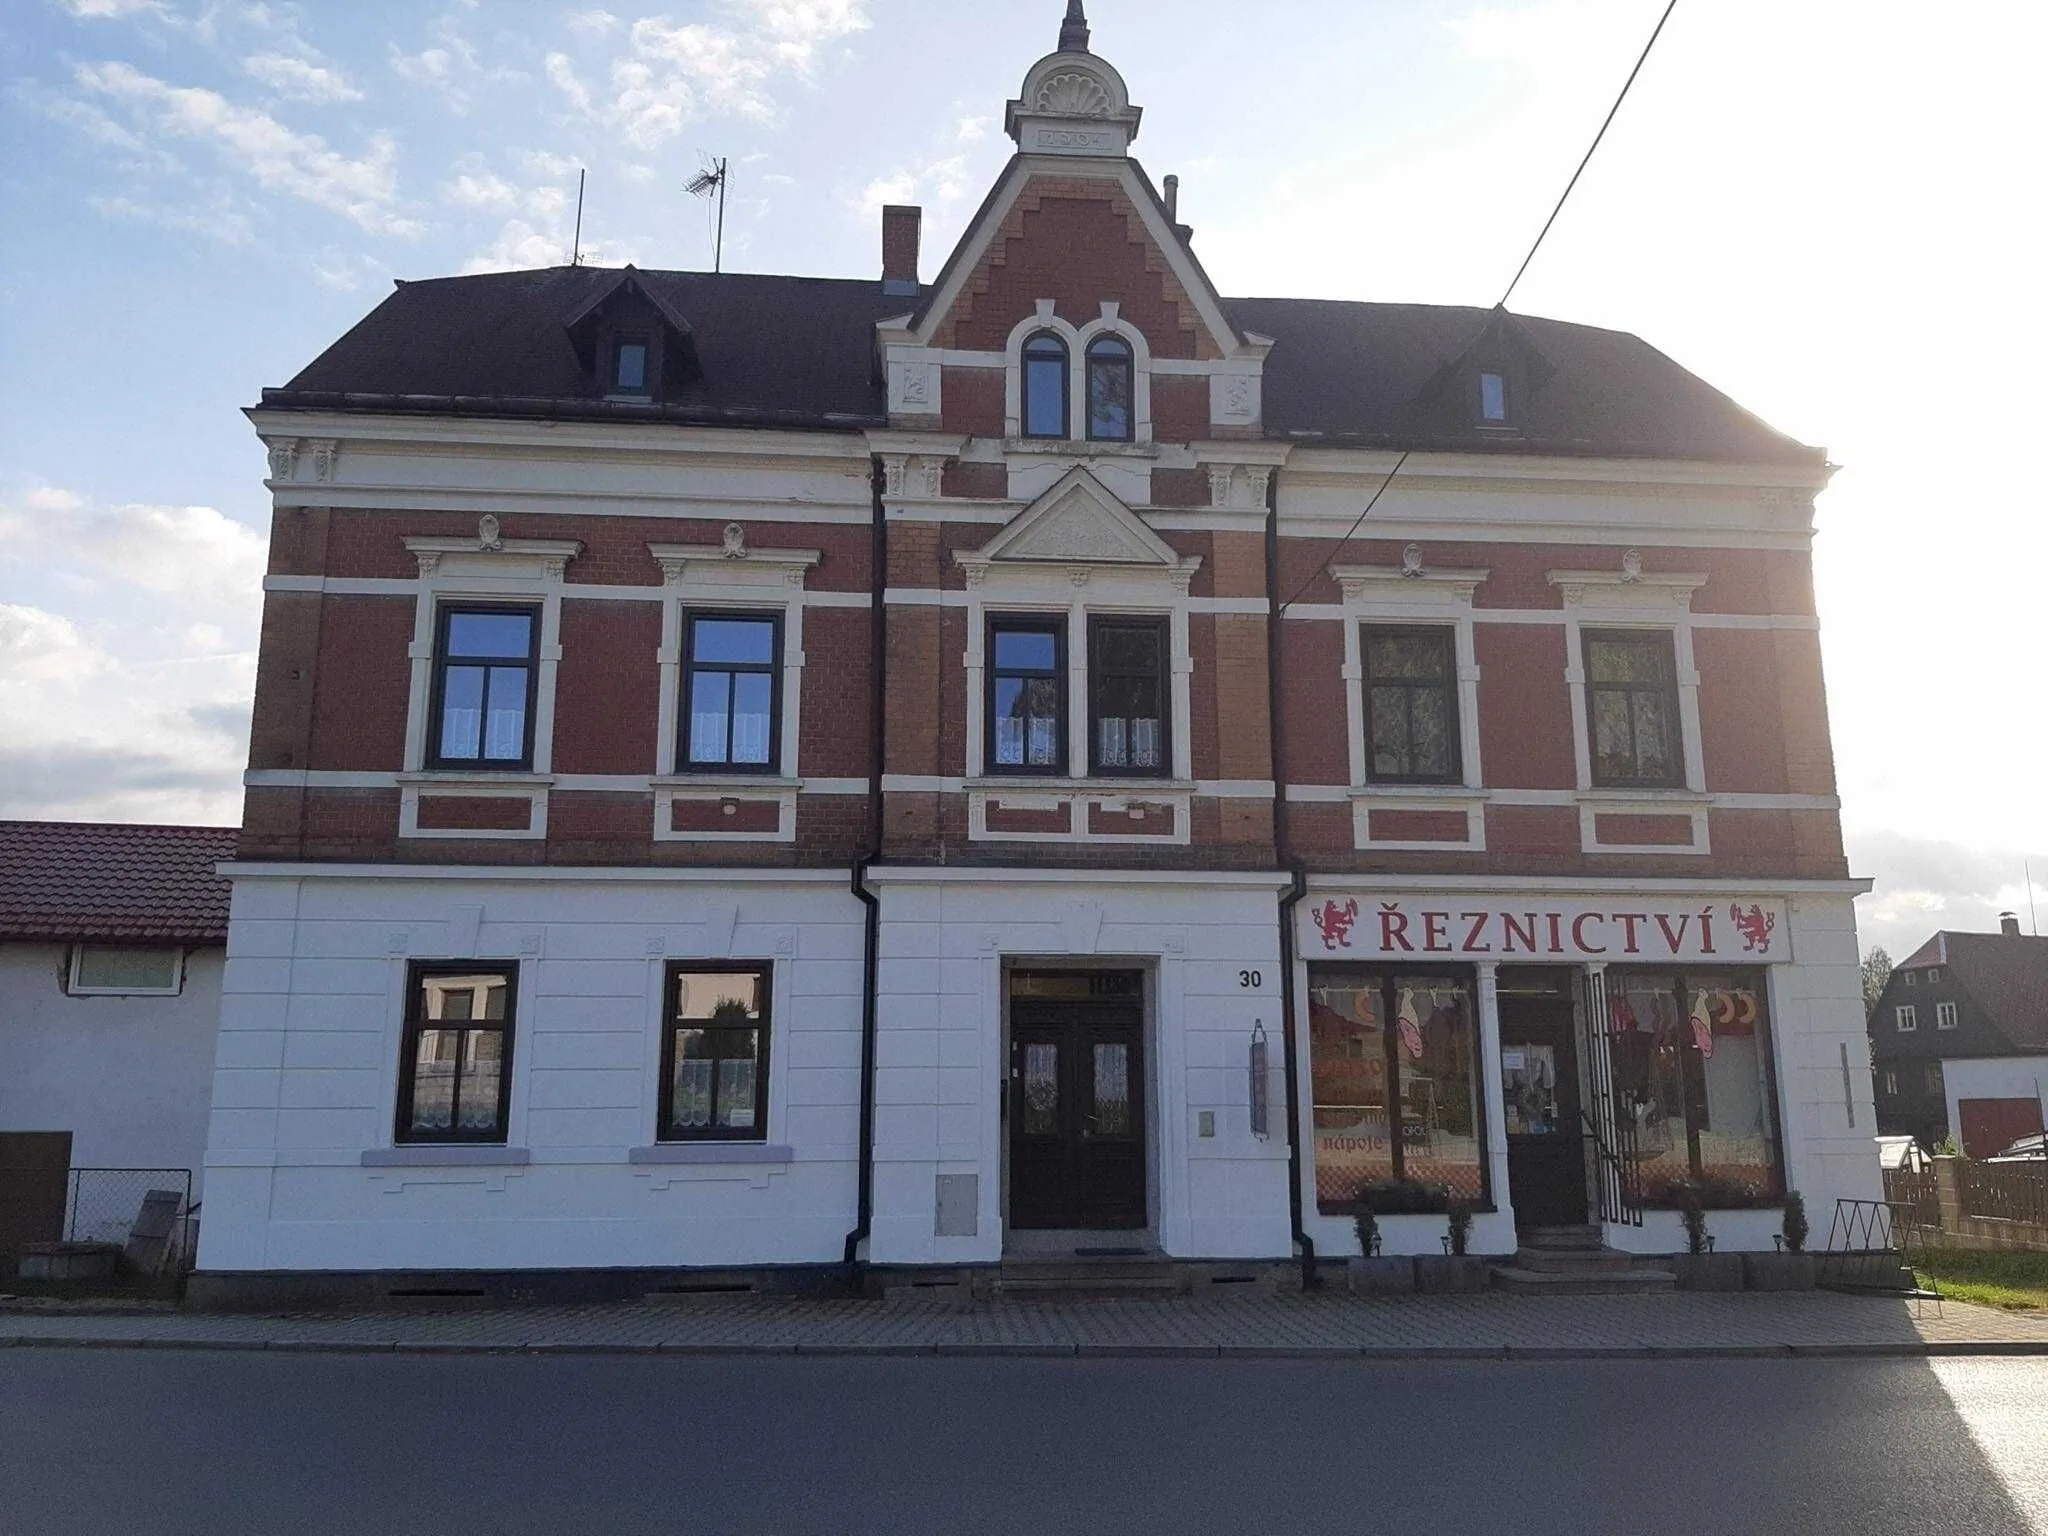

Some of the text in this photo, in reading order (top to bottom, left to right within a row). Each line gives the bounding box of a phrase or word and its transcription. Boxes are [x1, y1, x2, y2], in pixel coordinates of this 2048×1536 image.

[1378, 902, 1717, 954] ŘEZNICTVÍ
[1239, 970, 1262, 988] 30
[1323, 1134, 1384, 1153] nápoje
